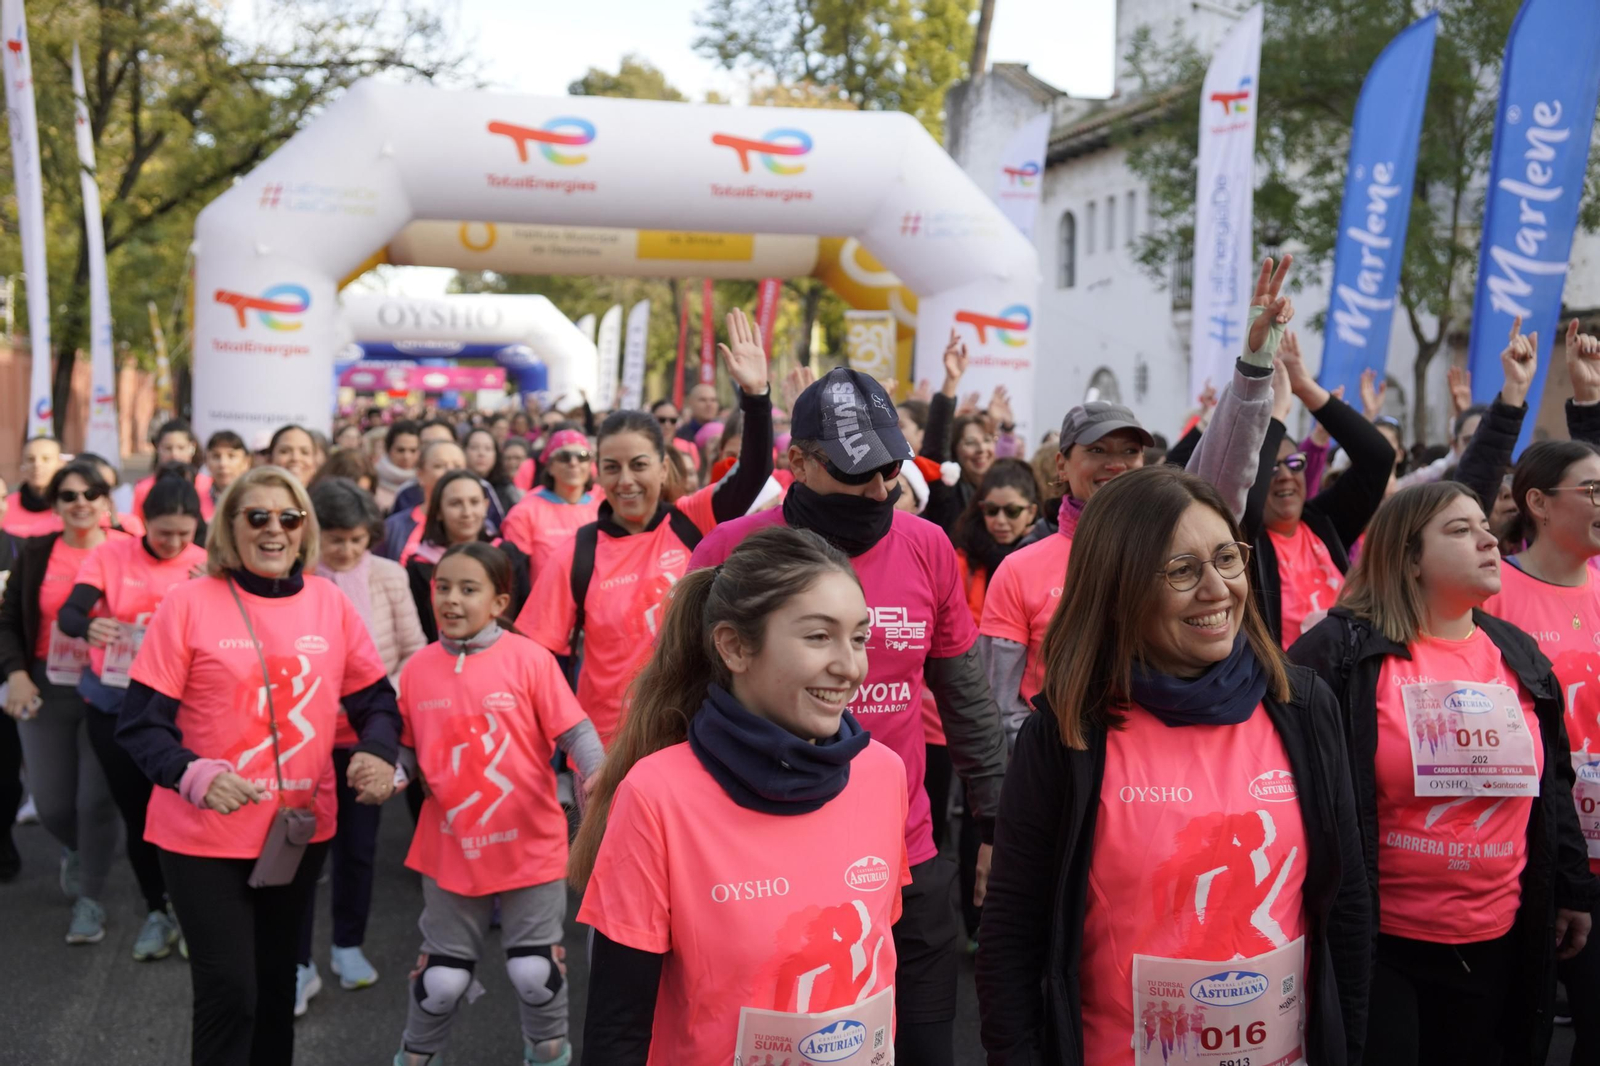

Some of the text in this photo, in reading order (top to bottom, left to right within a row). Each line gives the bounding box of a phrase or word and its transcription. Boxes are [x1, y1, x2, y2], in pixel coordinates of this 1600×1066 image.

[487, 173, 597, 194] TotalEnergies
[710, 184, 813, 203] TotalEnergies
[1486, 99, 1571, 320] Marlene
[1333, 161, 1401, 347] Marlene
[377, 303, 502, 329] OYSHO
[832, 382, 871, 465] SEVILLA
[600, 573, 639, 590] OYSHO
[885, 627, 925, 639] 2015
[857, 703, 908, 714] LANZAROTE
[1456, 729, 1500, 747] 016
[1472, 755, 1488, 764] 202
[1429, 780, 1528, 789] OYSHO Santander
[1119, 786, 1193, 803] OYSHO
[1387, 832, 1514, 858] CARRERA DE LA MUJER
[1447, 859, 1470, 871] 2025
[711, 877, 790, 903] OYSHO
[1149, 986, 1185, 998] SUMA
[1196, 982, 1264, 998] ASTURIANA
[765, 1034, 793, 1043] DORSAL
[804, 1033, 864, 1054] ASTURIANA
[1200, 1020, 1267, 1051] 016
[754, 1040, 792, 1053] SUMA
